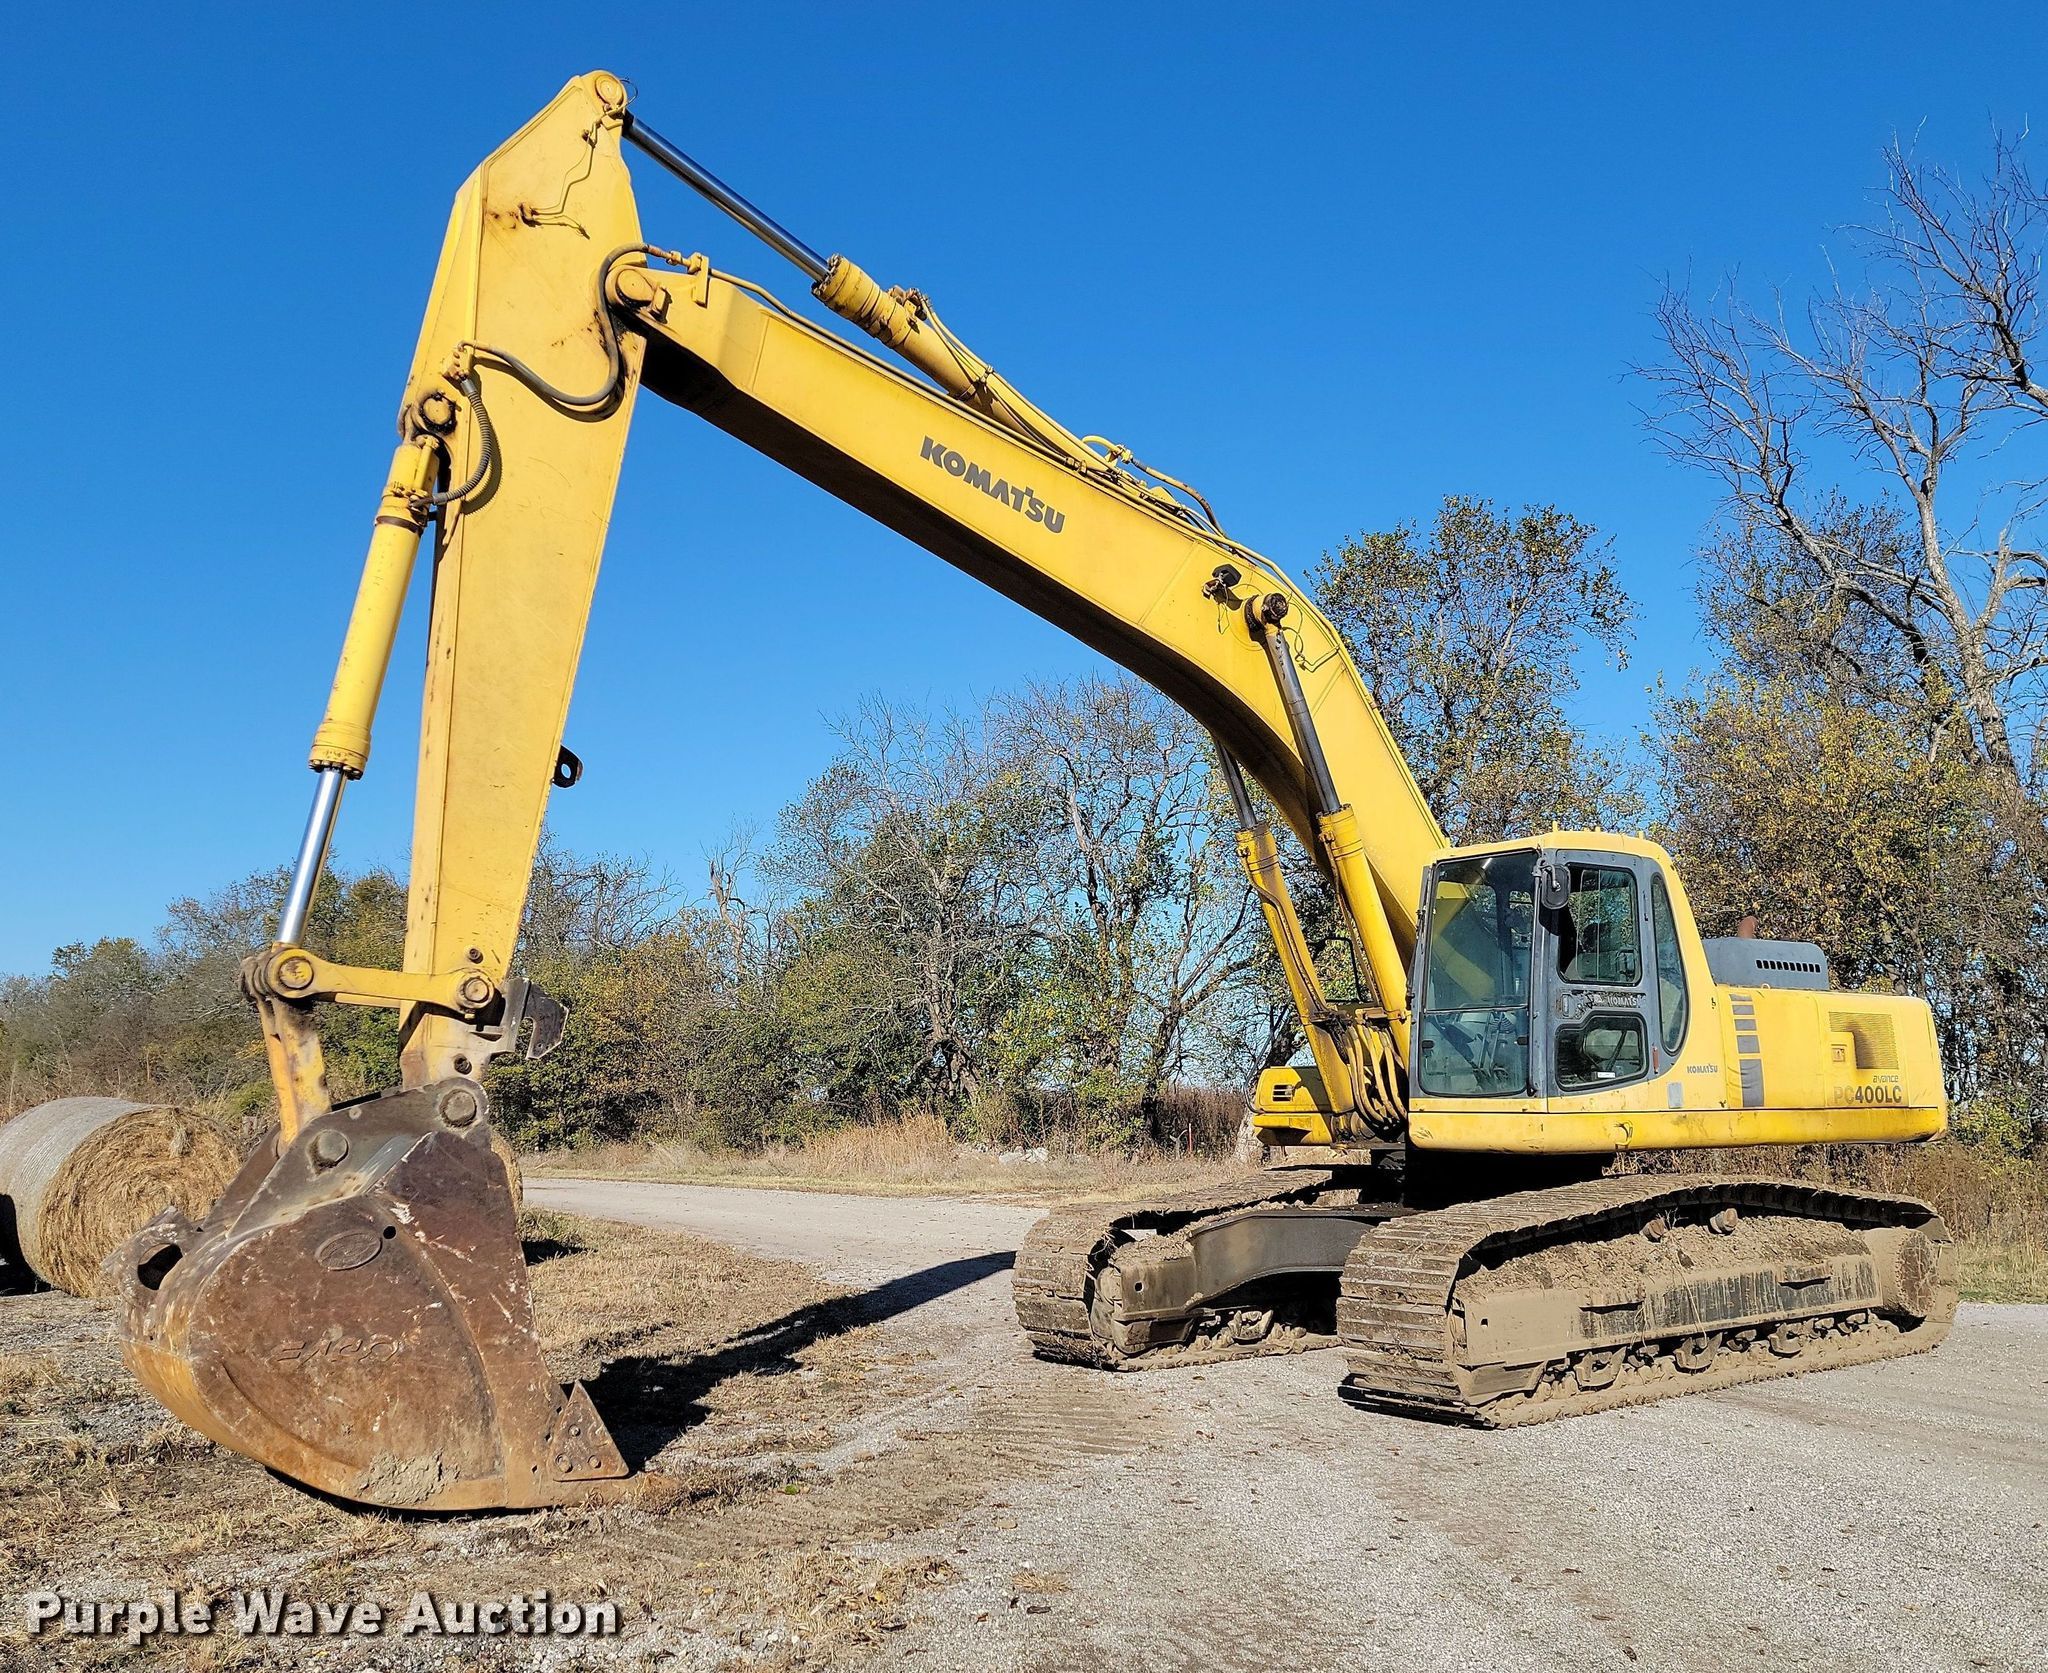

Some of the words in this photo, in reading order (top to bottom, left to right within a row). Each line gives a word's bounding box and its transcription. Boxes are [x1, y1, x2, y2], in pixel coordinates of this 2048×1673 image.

[920, 435, 1066, 534] KOMATSU
[1687, 1064, 1718, 1073] KOMATSU
[1833, 1085, 1902, 1104] PC400LC
